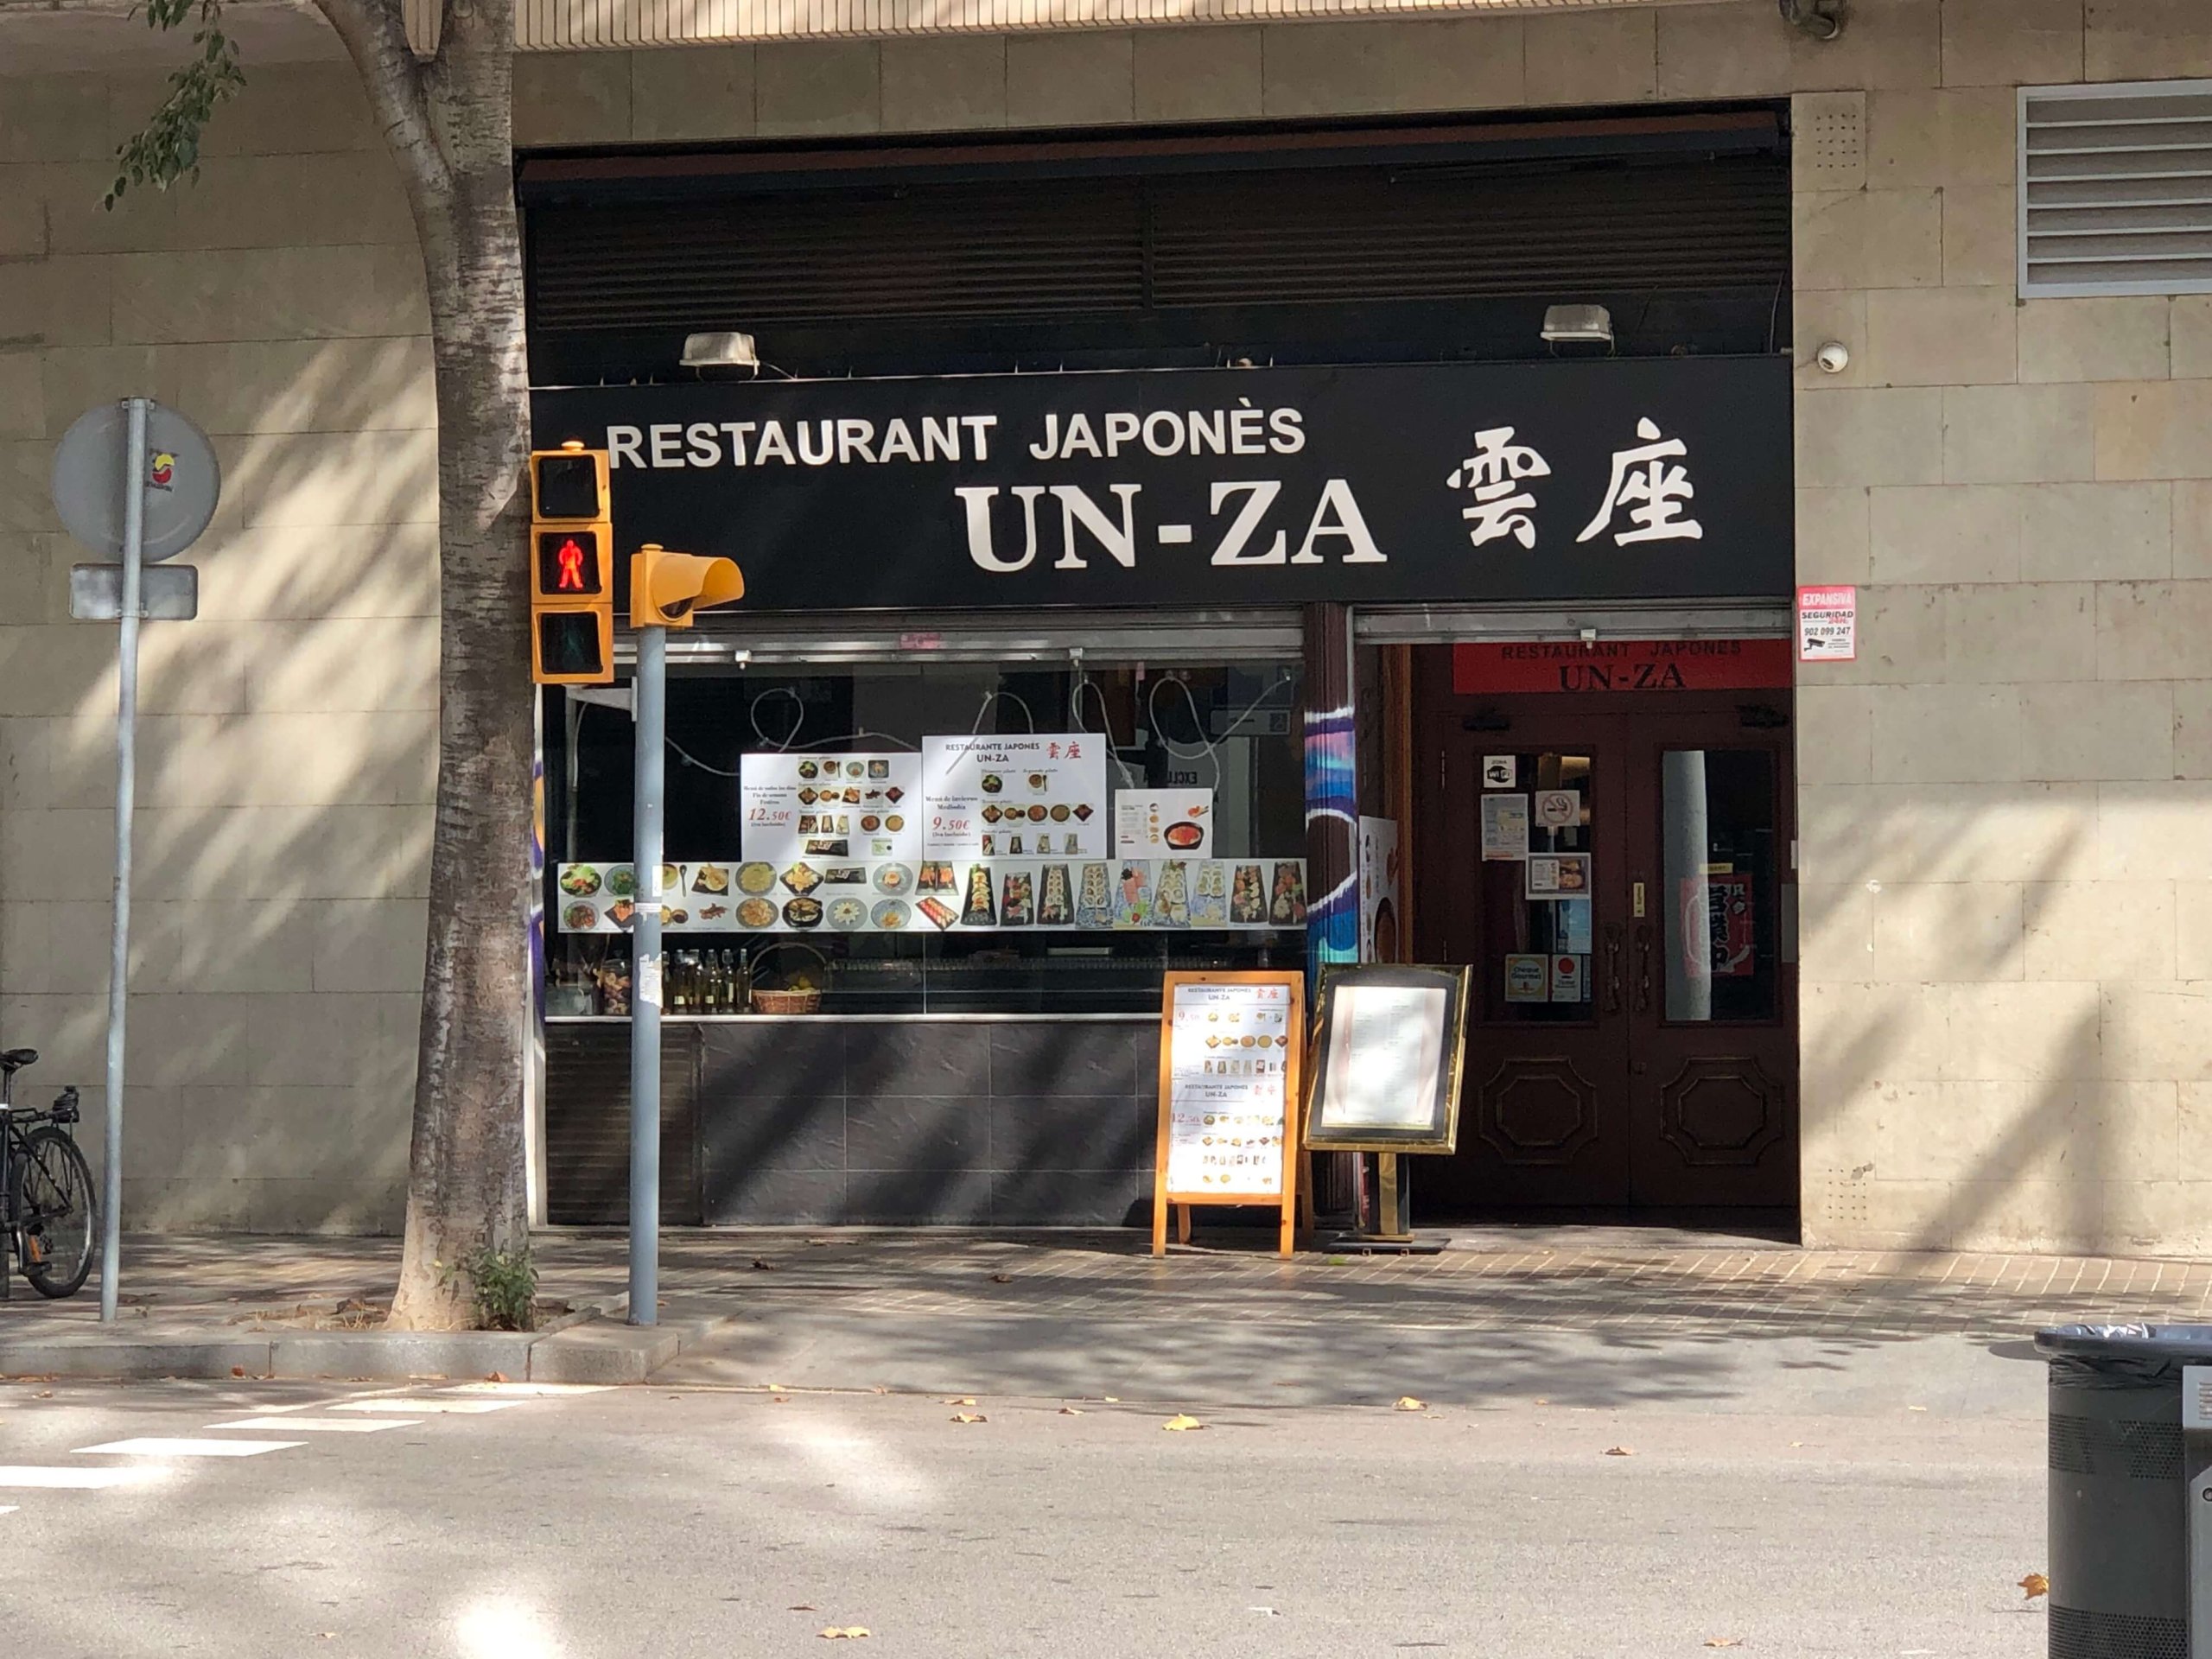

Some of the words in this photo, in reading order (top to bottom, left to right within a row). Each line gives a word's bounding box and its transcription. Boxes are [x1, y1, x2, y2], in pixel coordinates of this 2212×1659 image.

[607, 415, 997, 468] RESTAURANT
[1029, 397, 1306, 460] JAPONÈS
[1446, 416, 1704, 550] 雲座
[954, 478, 1389, 573] UN-ZA
[1802, 593, 1853, 606] EXPANSIVA
[1802, 611, 1854, 620] SEGURIDAD
[1804, 627, 1819, 636] 902
[1820, 626, 1834, 635] 099
[1836, 626, 1851, 635] 247
[1502, 641, 1630, 659] RESTAURANT
[1559, 664, 1687, 690] UN-ZA
[976, 753, 1009, 763] UN-ZA
